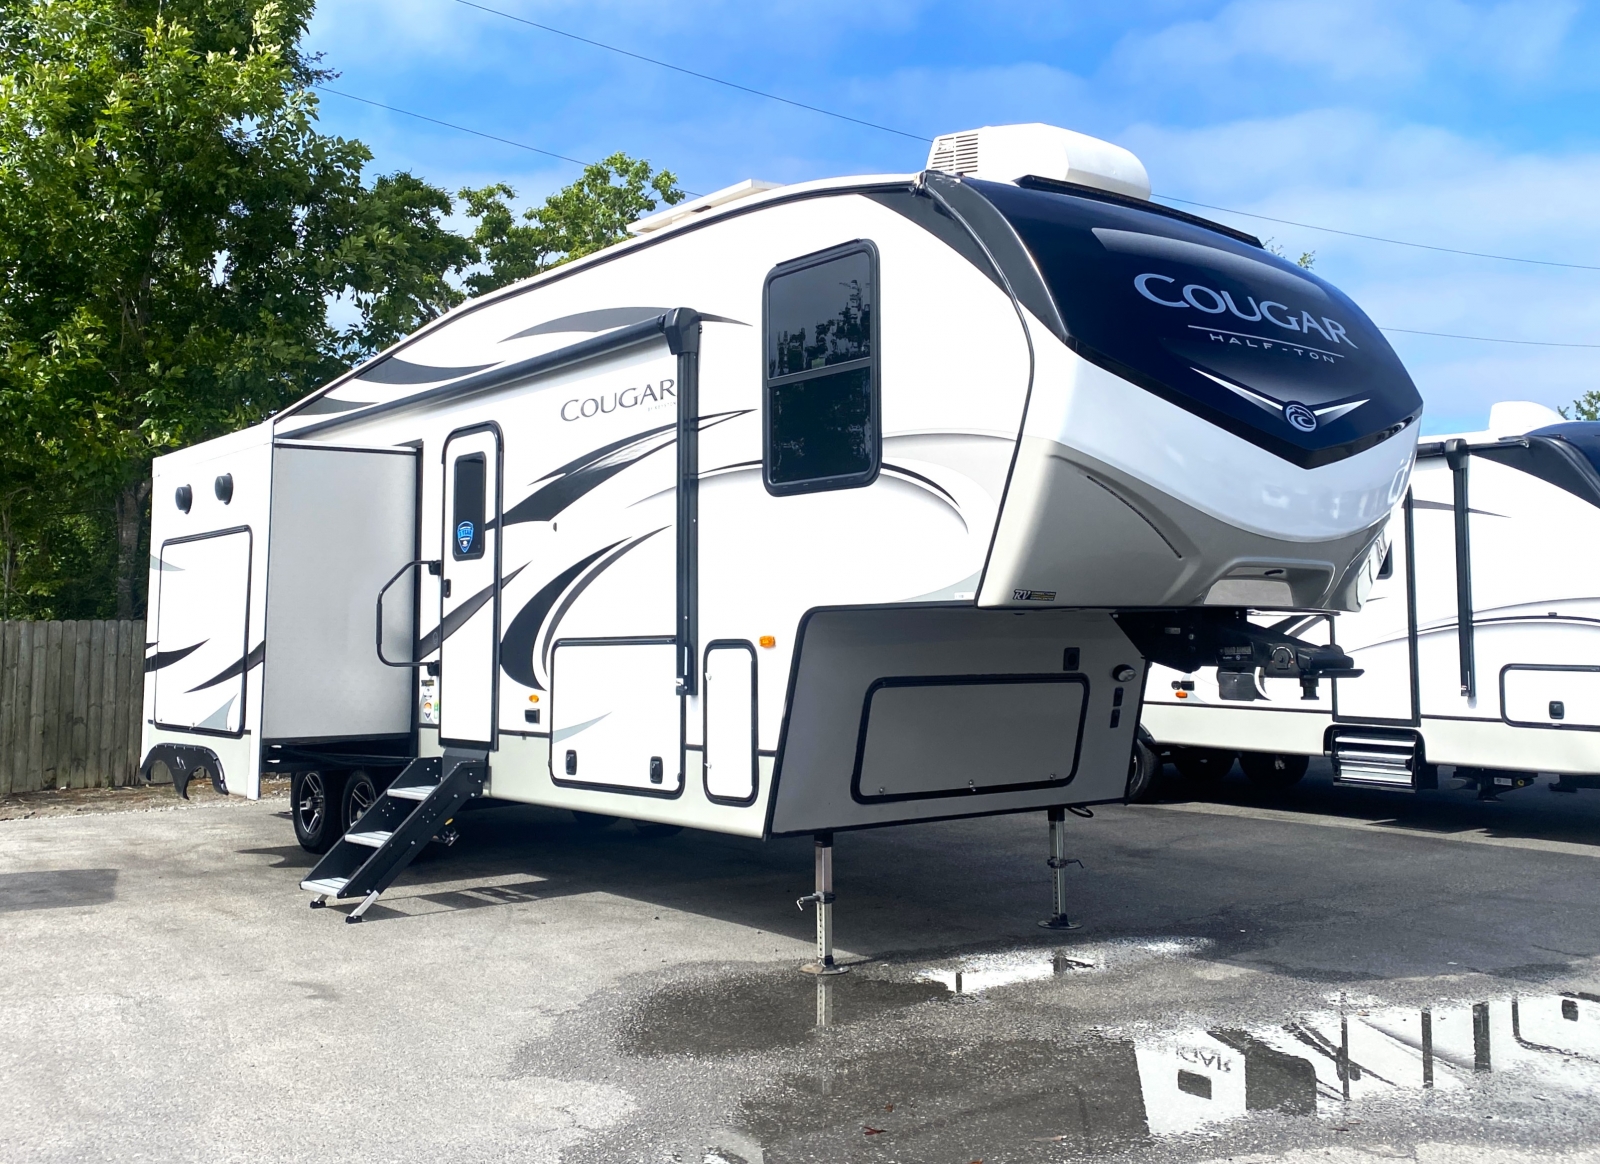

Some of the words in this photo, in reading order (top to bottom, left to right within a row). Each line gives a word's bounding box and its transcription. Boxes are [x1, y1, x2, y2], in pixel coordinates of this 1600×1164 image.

[1133, 273, 1359, 349] COUGAR
[560, 379, 676, 422] COUGAR
[1013, 589, 1031, 600] RV
